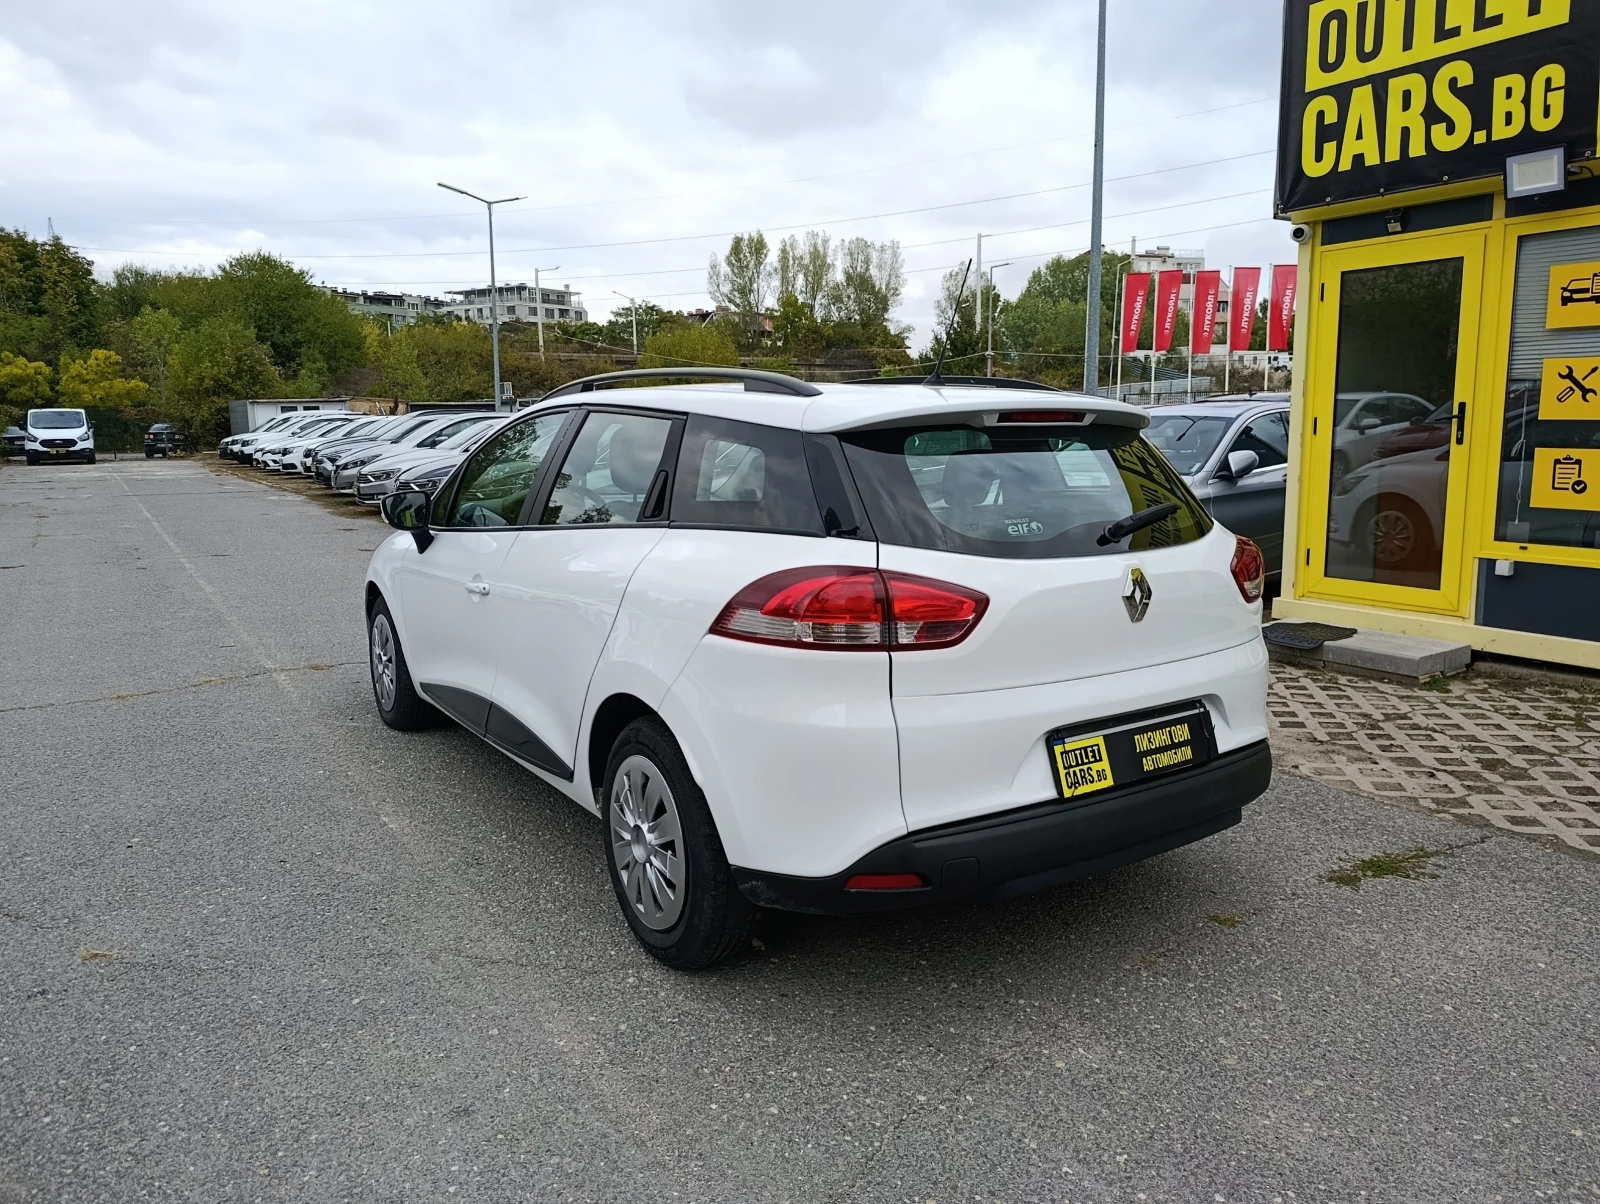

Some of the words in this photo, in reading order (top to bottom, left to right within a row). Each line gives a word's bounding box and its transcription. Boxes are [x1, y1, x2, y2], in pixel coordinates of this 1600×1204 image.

[1318, 0, 1541, 74] OUTL
[1301, 60, 1566, 178] CARS.BG
[1130, 295, 1143, 331] ЛУКОЙЛ
[1165, 293, 1177, 330] ЛУКОЙЛ
[1204, 294, 1215, 332] ЛУКОЙЛ
[1241, 291, 1253, 328] ЛУКОЙЛ
[1004, 517, 1029, 525] RENAULT
[1007, 523, 1030, 535] elf
[1134, 723, 1191, 753] ЛИЗИНГОВИ
[1062, 745, 1100, 768] OUTLET
[1142, 745, 1193, 772] АВТОМОБИЛИ
[1064, 766, 1108, 790] CARS.BG
